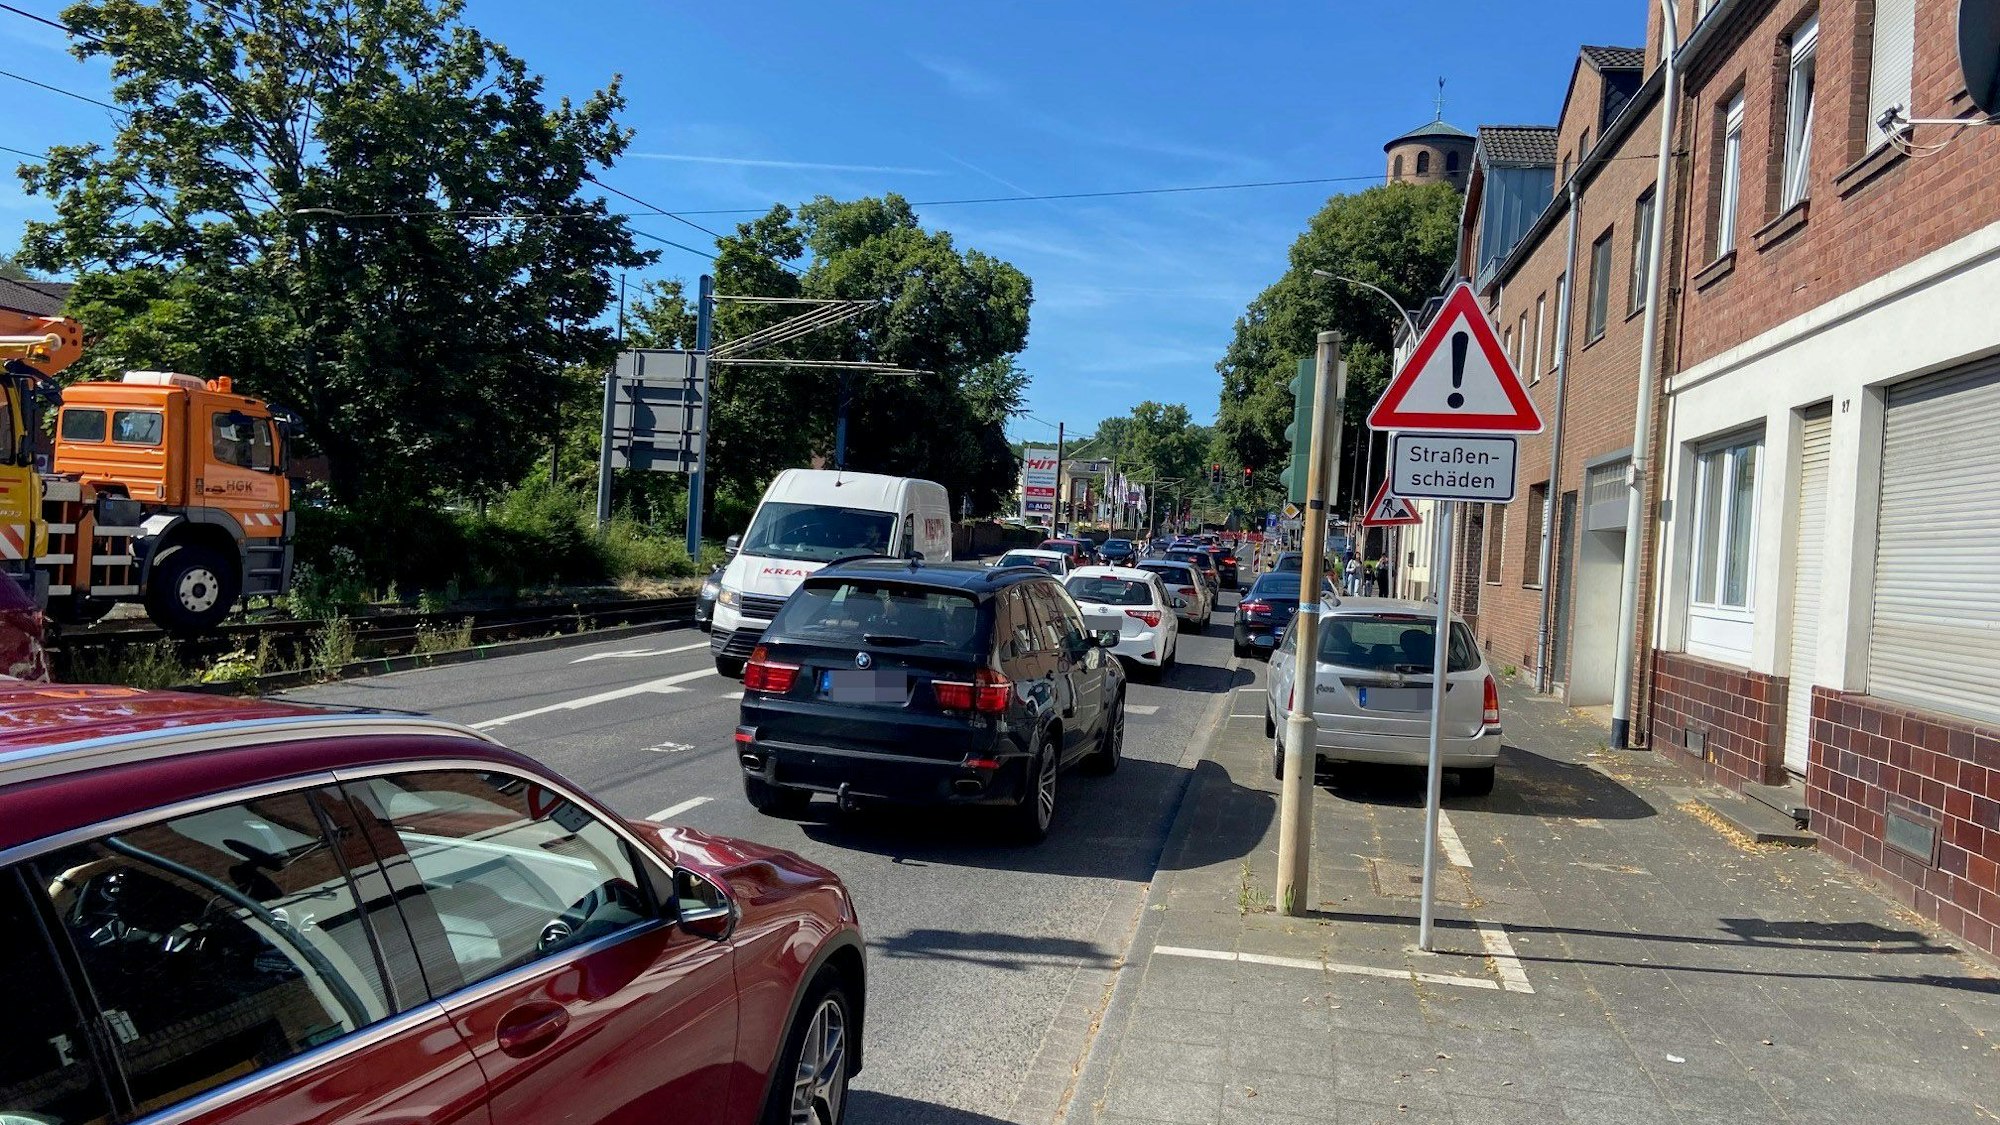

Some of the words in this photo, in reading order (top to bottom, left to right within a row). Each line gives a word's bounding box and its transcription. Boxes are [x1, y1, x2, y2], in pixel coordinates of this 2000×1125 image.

[1409, 446, 1500, 464] Straßen-
[1028, 458, 1057, 470] HIT
[226, 480, 253, 491] HGK
[1411, 470, 1495, 488] schäden
